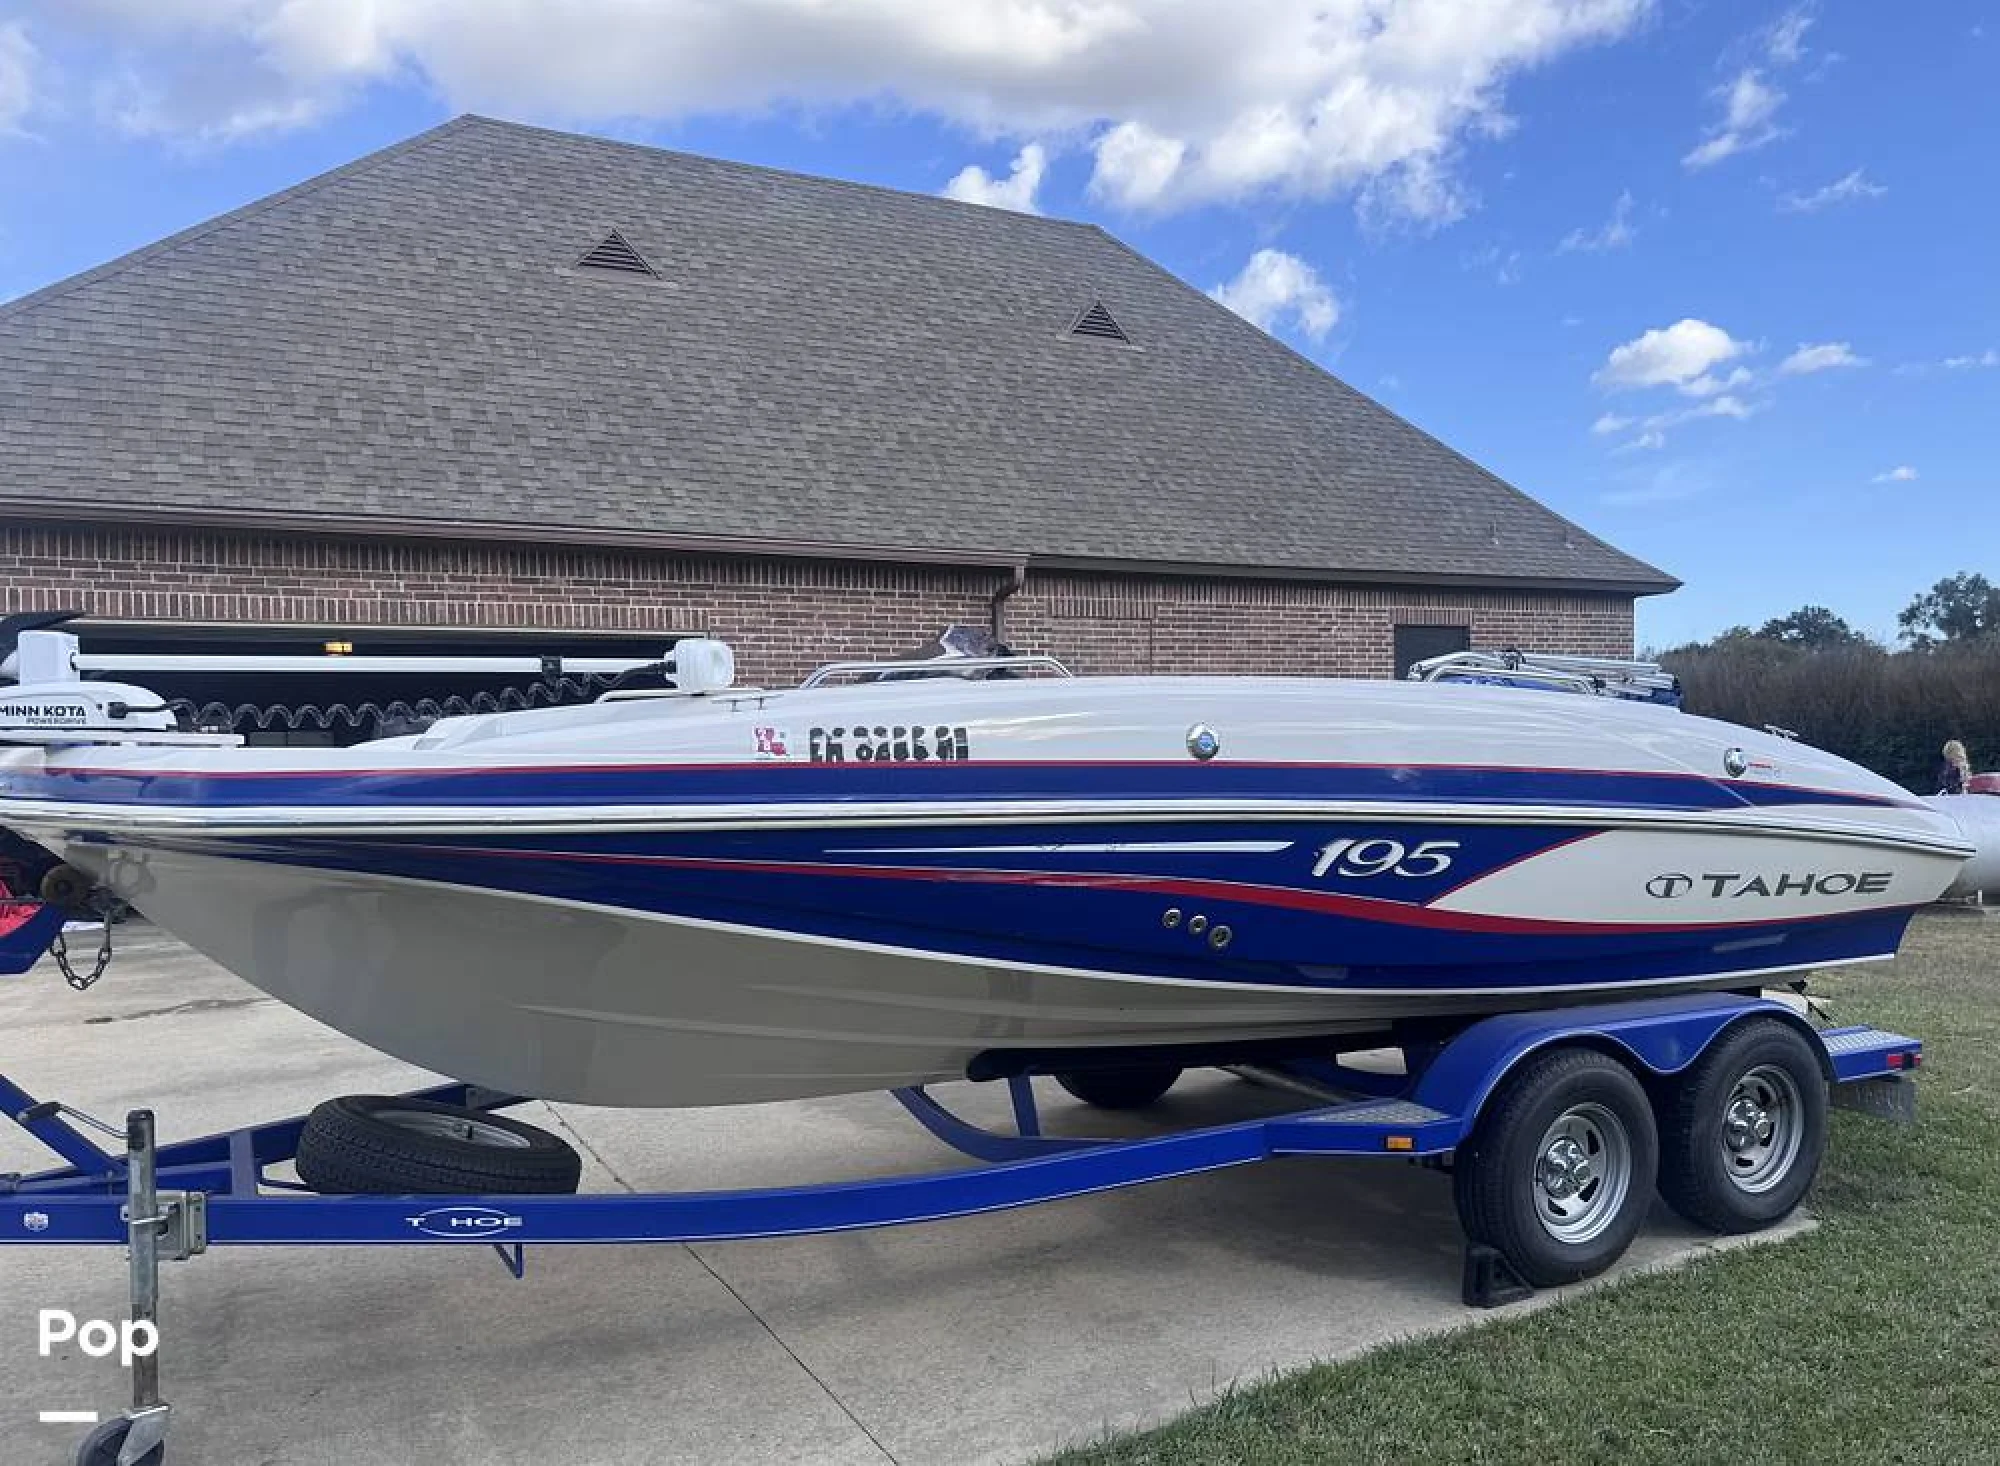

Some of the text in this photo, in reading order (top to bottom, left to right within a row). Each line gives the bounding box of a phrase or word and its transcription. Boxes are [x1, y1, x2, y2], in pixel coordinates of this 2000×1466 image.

[44, 706, 86, 716] KOTA
[1312, 839, 1461, 877] 195
[1702, 872, 1893, 898] TAHOE
[404, 1216, 523, 1227] THOE
